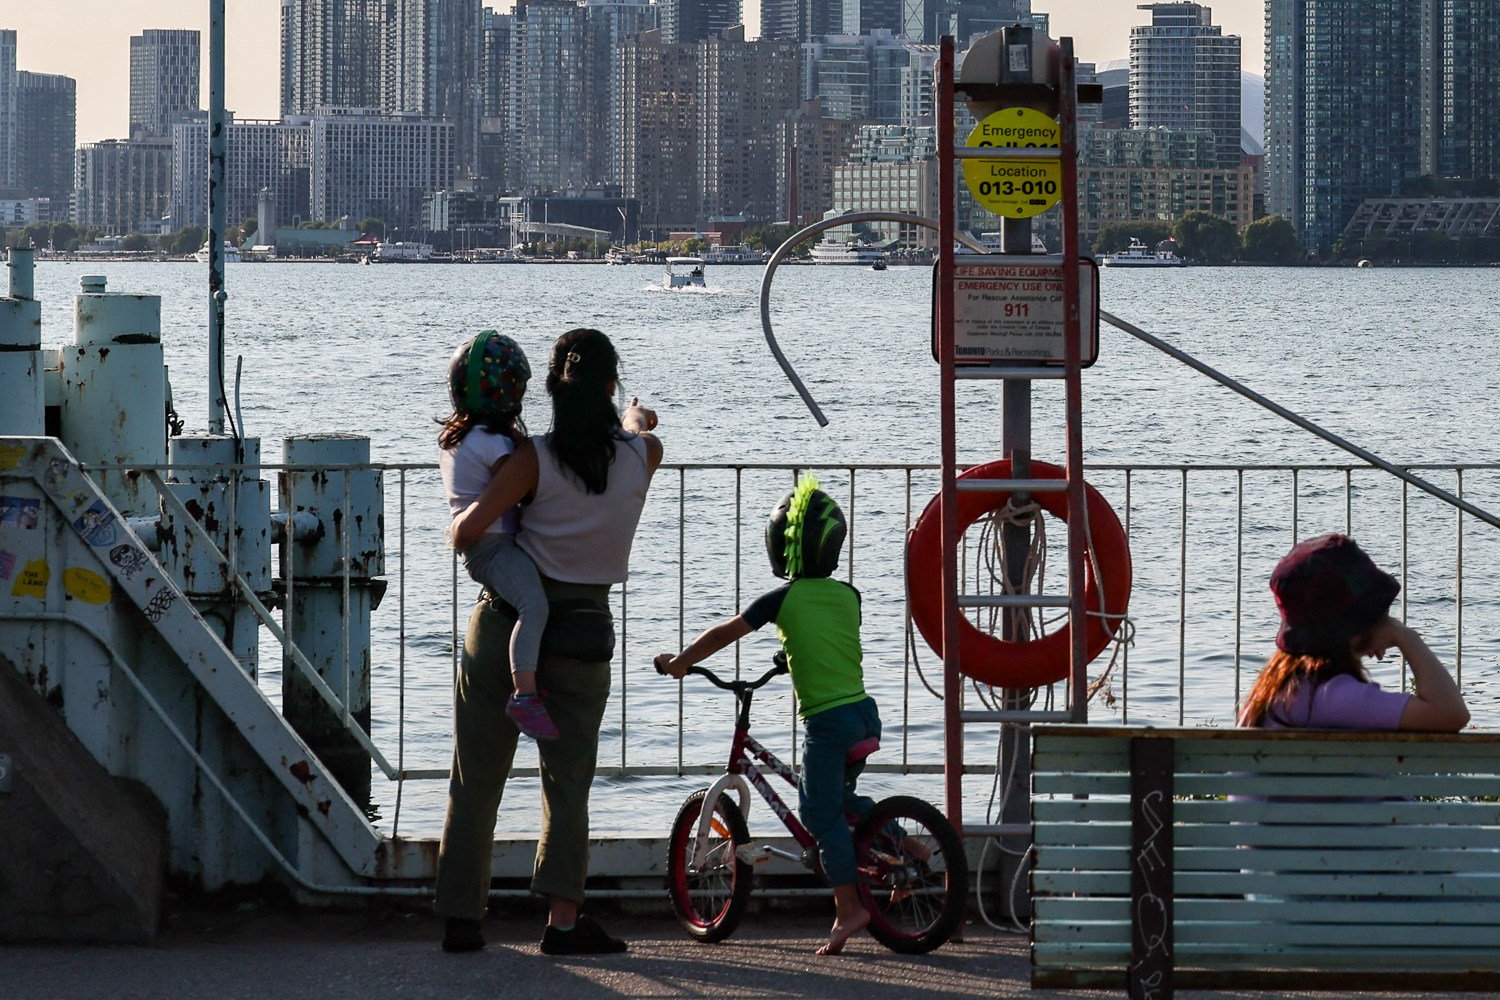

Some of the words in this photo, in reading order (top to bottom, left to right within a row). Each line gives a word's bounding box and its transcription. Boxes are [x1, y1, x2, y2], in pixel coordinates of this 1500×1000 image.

[982, 124, 1057, 140] Emergency
[991, 165, 1047, 177] Location
[979, 181, 1057, 195] 013-010
[955, 268, 974, 276] LIFE
[978, 268, 1016, 277] SAVING
[1019, 268, 1064, 278] EQUIPME
[958, 282, 1019, 291] EMERGENCY
[1022, 282, 1042, 291] USE
[1045, 283, 1064, 292] ONL
[1004, 303, 1029, 317] 911
[955, 345, 985, 355] TORONTO
